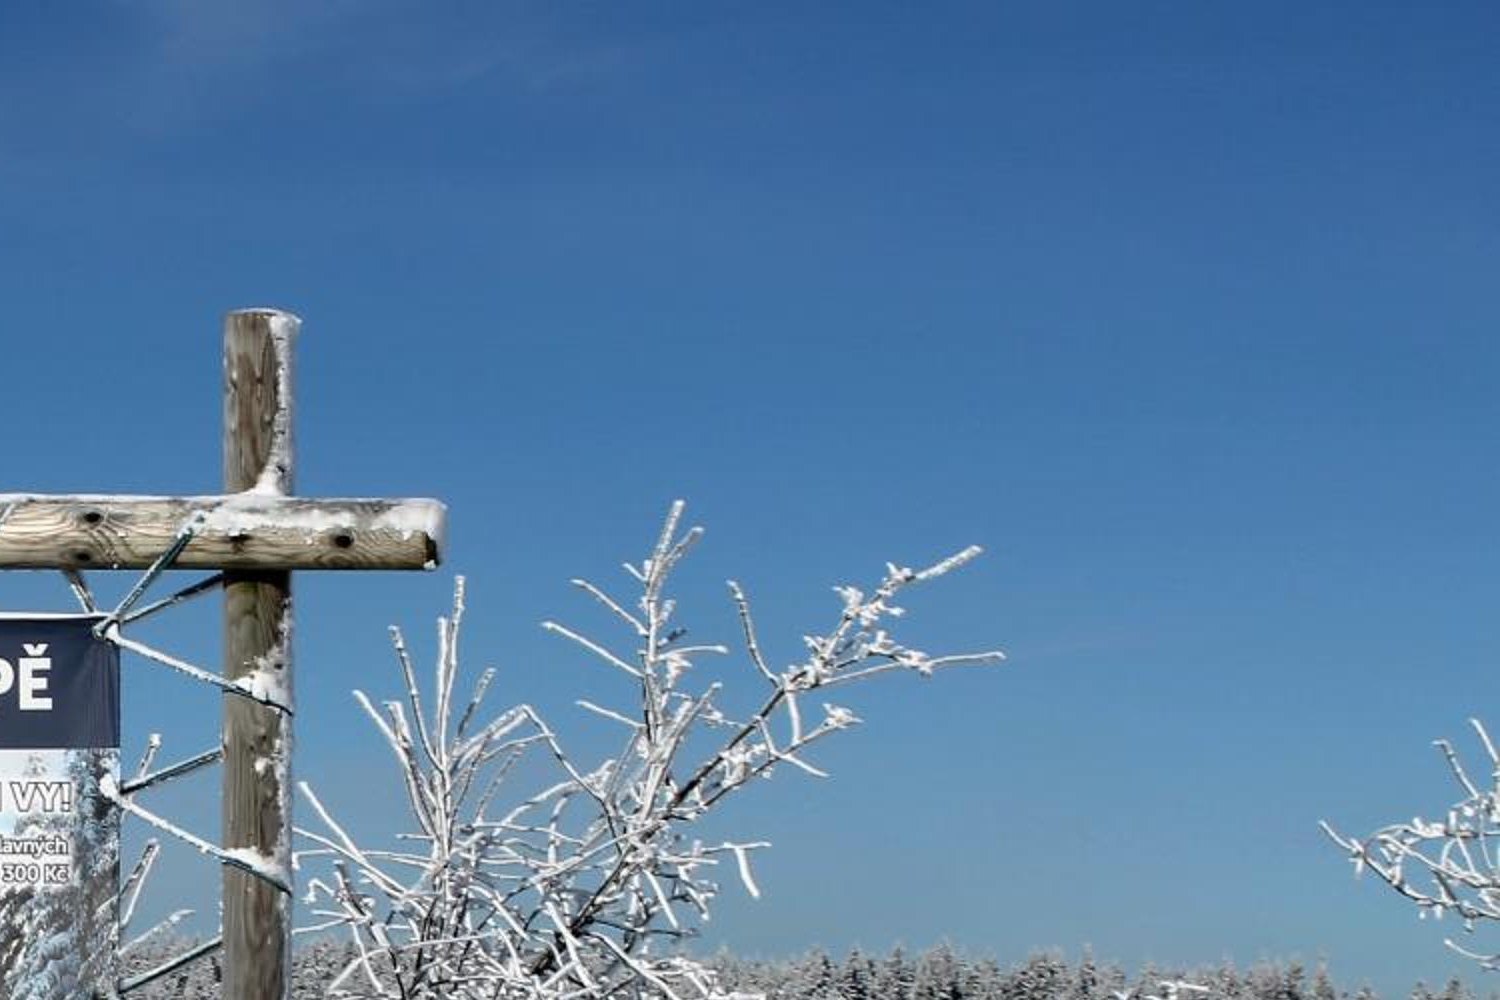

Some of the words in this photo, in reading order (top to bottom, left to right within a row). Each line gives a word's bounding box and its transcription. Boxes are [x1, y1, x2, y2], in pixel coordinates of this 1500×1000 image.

[10, 781, 72, 812] VY!
[2, 864, 40, 883] 300
[44, 863, 70, 883] Kč
